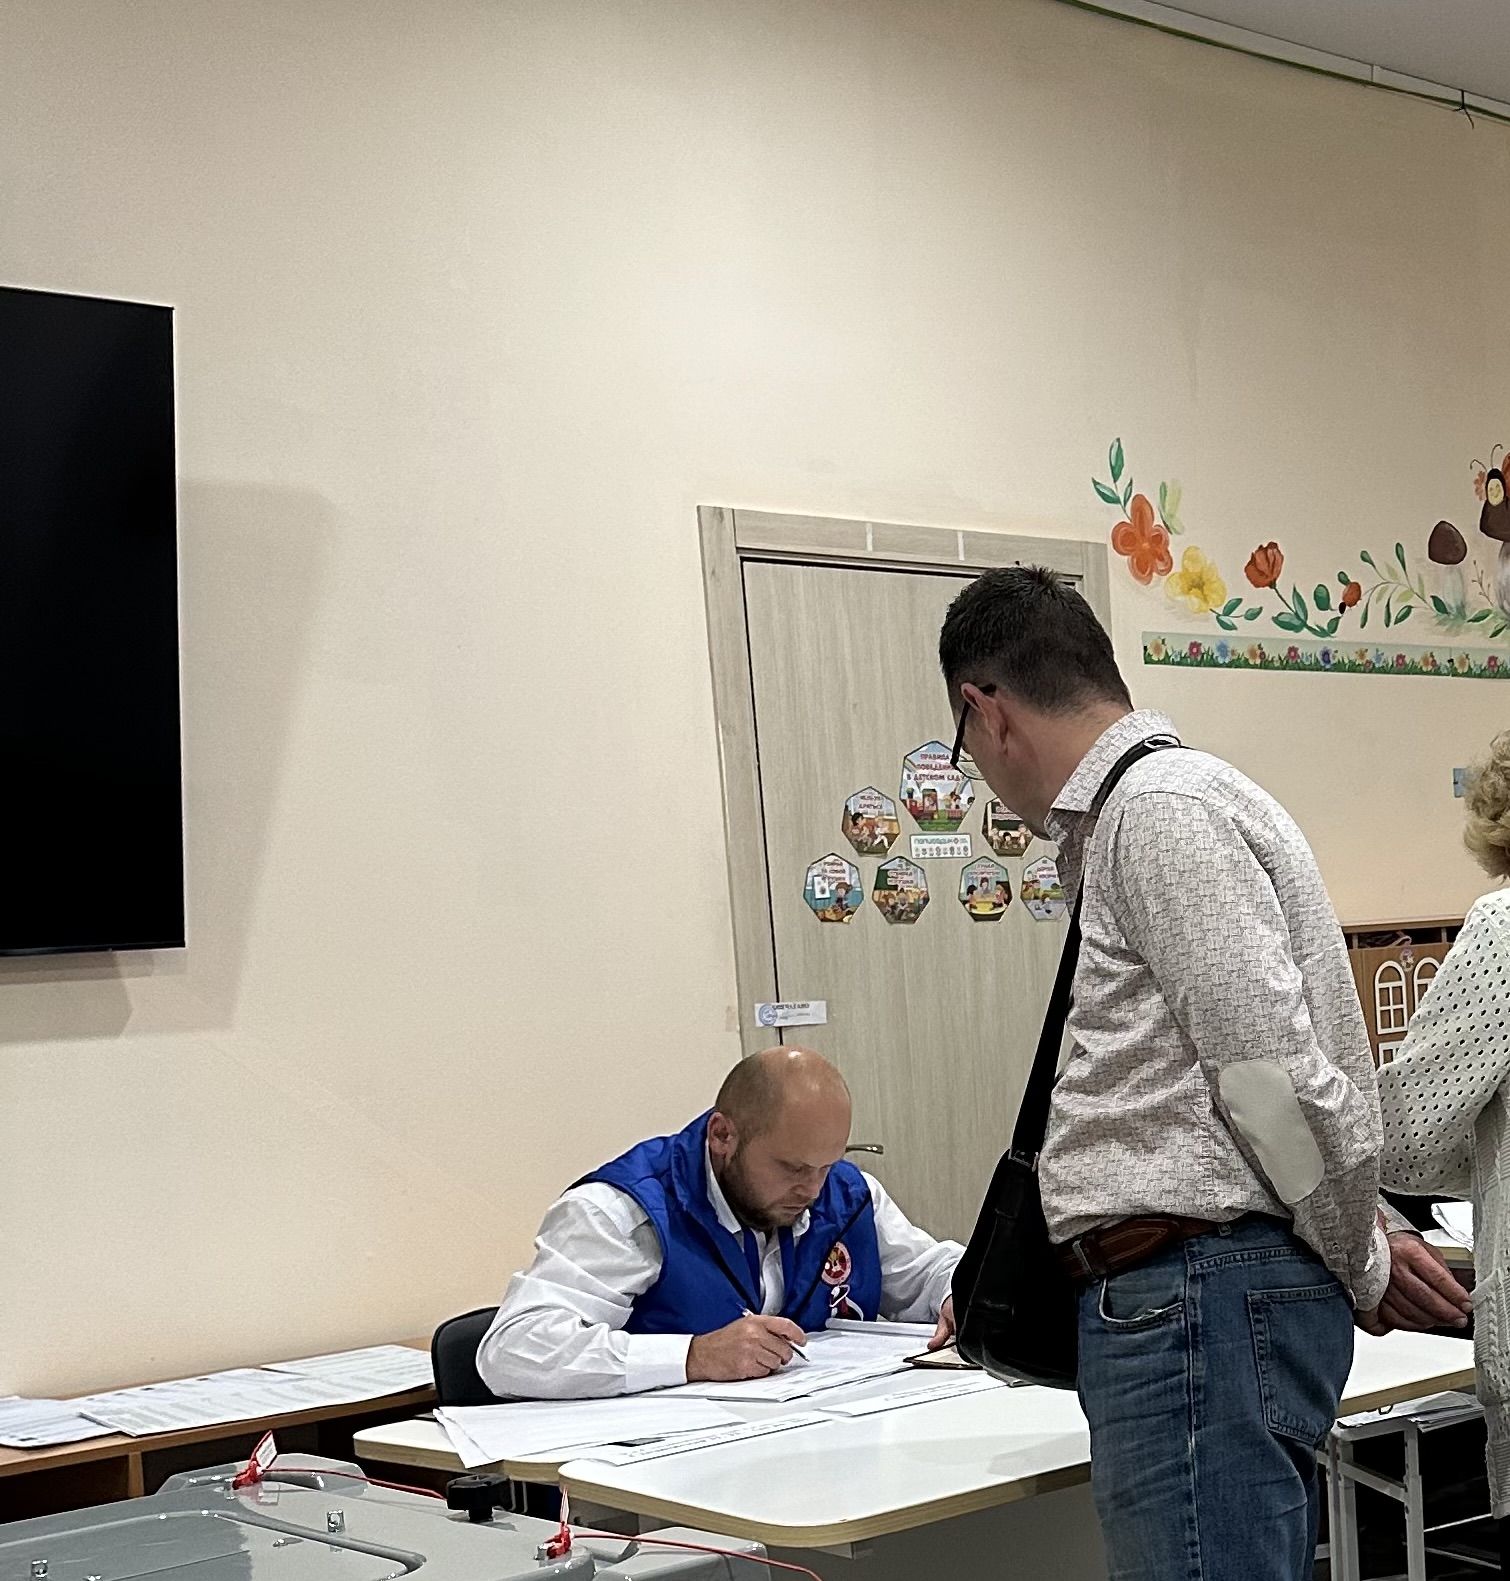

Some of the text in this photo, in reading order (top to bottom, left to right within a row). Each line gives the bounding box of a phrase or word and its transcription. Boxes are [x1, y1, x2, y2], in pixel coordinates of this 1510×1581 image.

[920, 753, 950, 761] ПРАВИЛА
[916, 763, 956, 772] ПОВЕДЕНИ
[914, 773, 945, 781] ДЕТСКОМ
